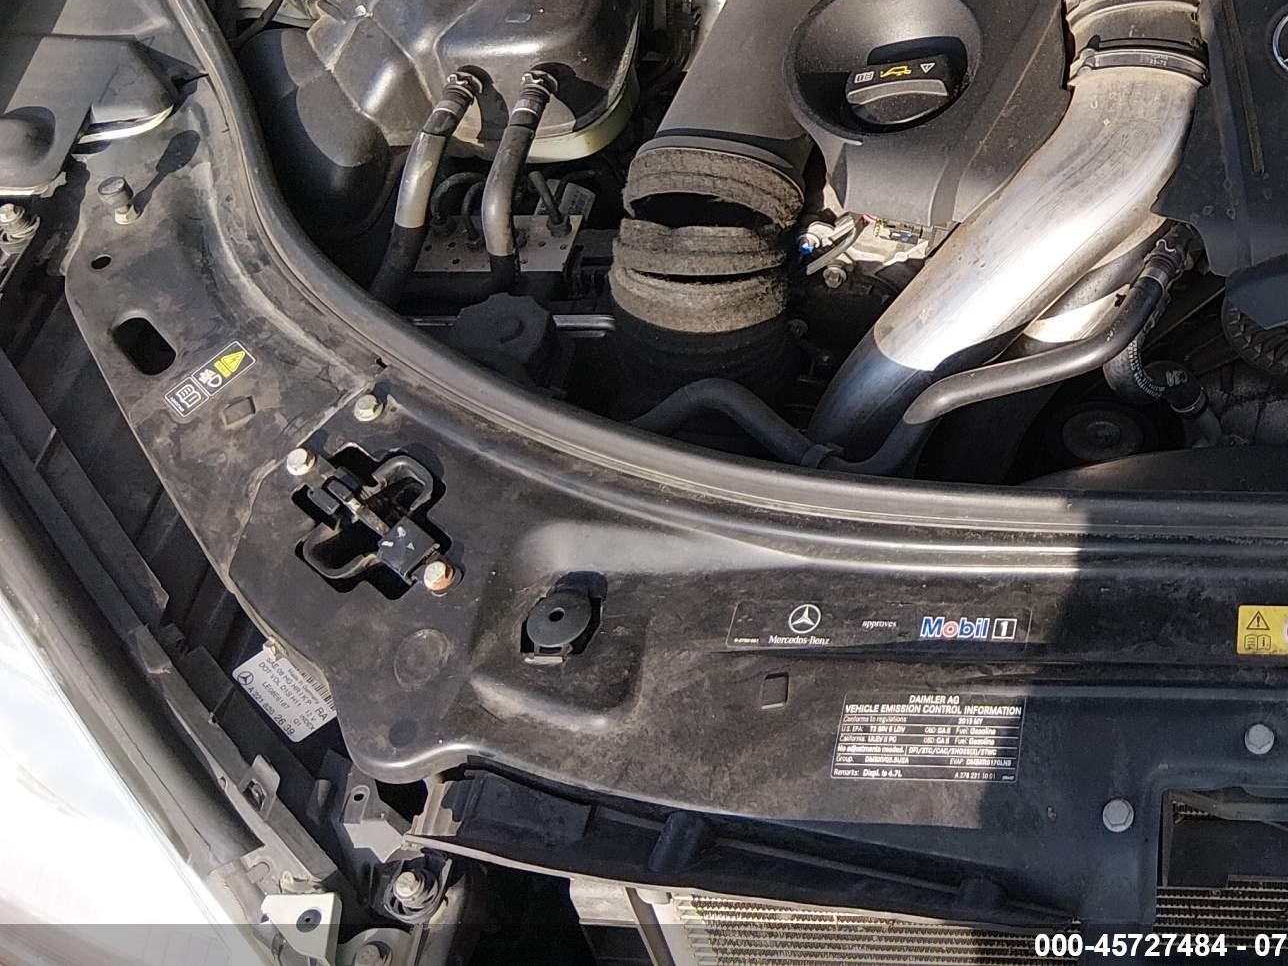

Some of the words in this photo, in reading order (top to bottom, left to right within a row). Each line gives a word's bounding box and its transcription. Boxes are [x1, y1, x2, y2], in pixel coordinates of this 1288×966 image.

[862, 620, 897, 628] approves
[920, 616, 991, 639] Mobil
[768, 635, 830, 645] Mercedes-Benz
[909, 695, 946, 705] DAIMLER
[946, 695, 960, 705] AG
[314, 706, 328, 721] RA
[845, 704, 880, 713] VEHICLE
[880, 704, 921, 714] EMISSION
[922, 705, 962, 714] CONTROL
[964, 705, 1022, 715] INFORMATION
[274, 714, 285, 725] 26
